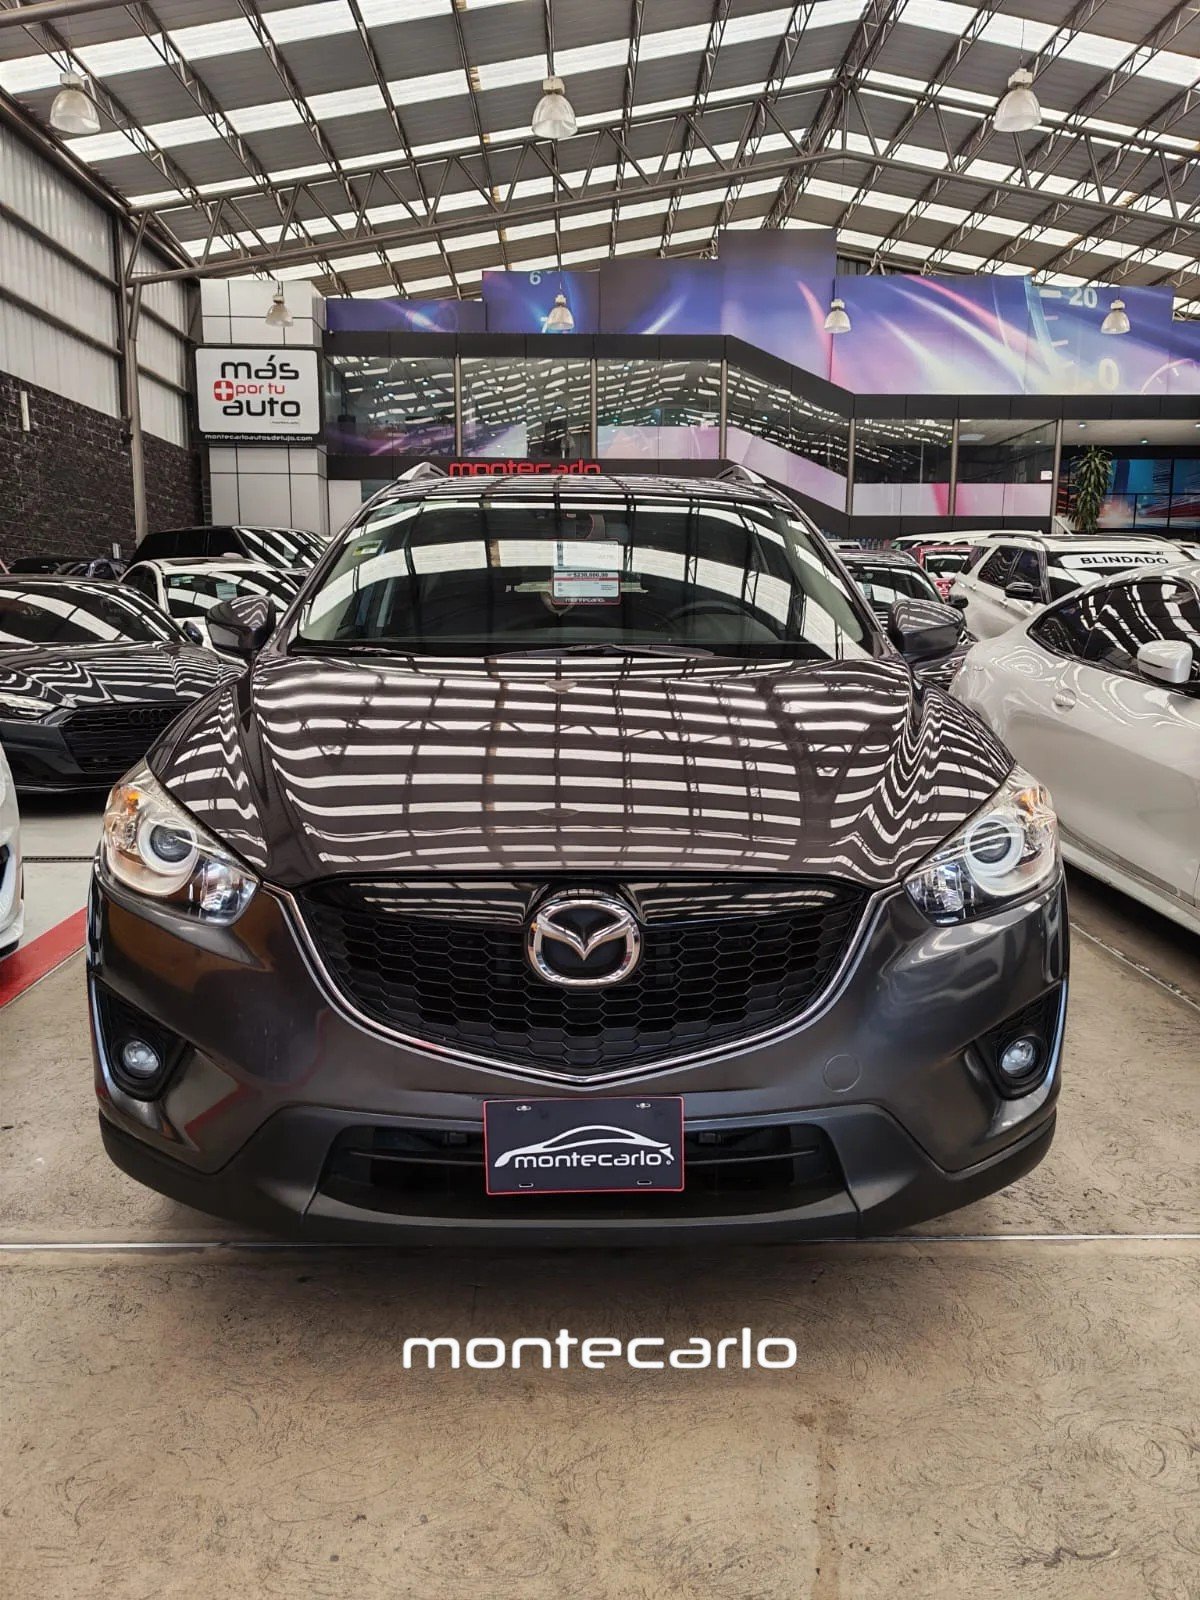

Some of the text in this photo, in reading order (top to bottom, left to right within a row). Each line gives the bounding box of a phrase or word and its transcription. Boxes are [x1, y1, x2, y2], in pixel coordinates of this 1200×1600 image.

[1068, 287, 1098, 309] 20
[221, 354, 300, 379] más
[235, 382, 285, 396] por tu
[222, 397, 301, 417] auto
[1080, 556, 1169, 564] BLINDADO
[514, 1150, 662, 1169] montecarlo
